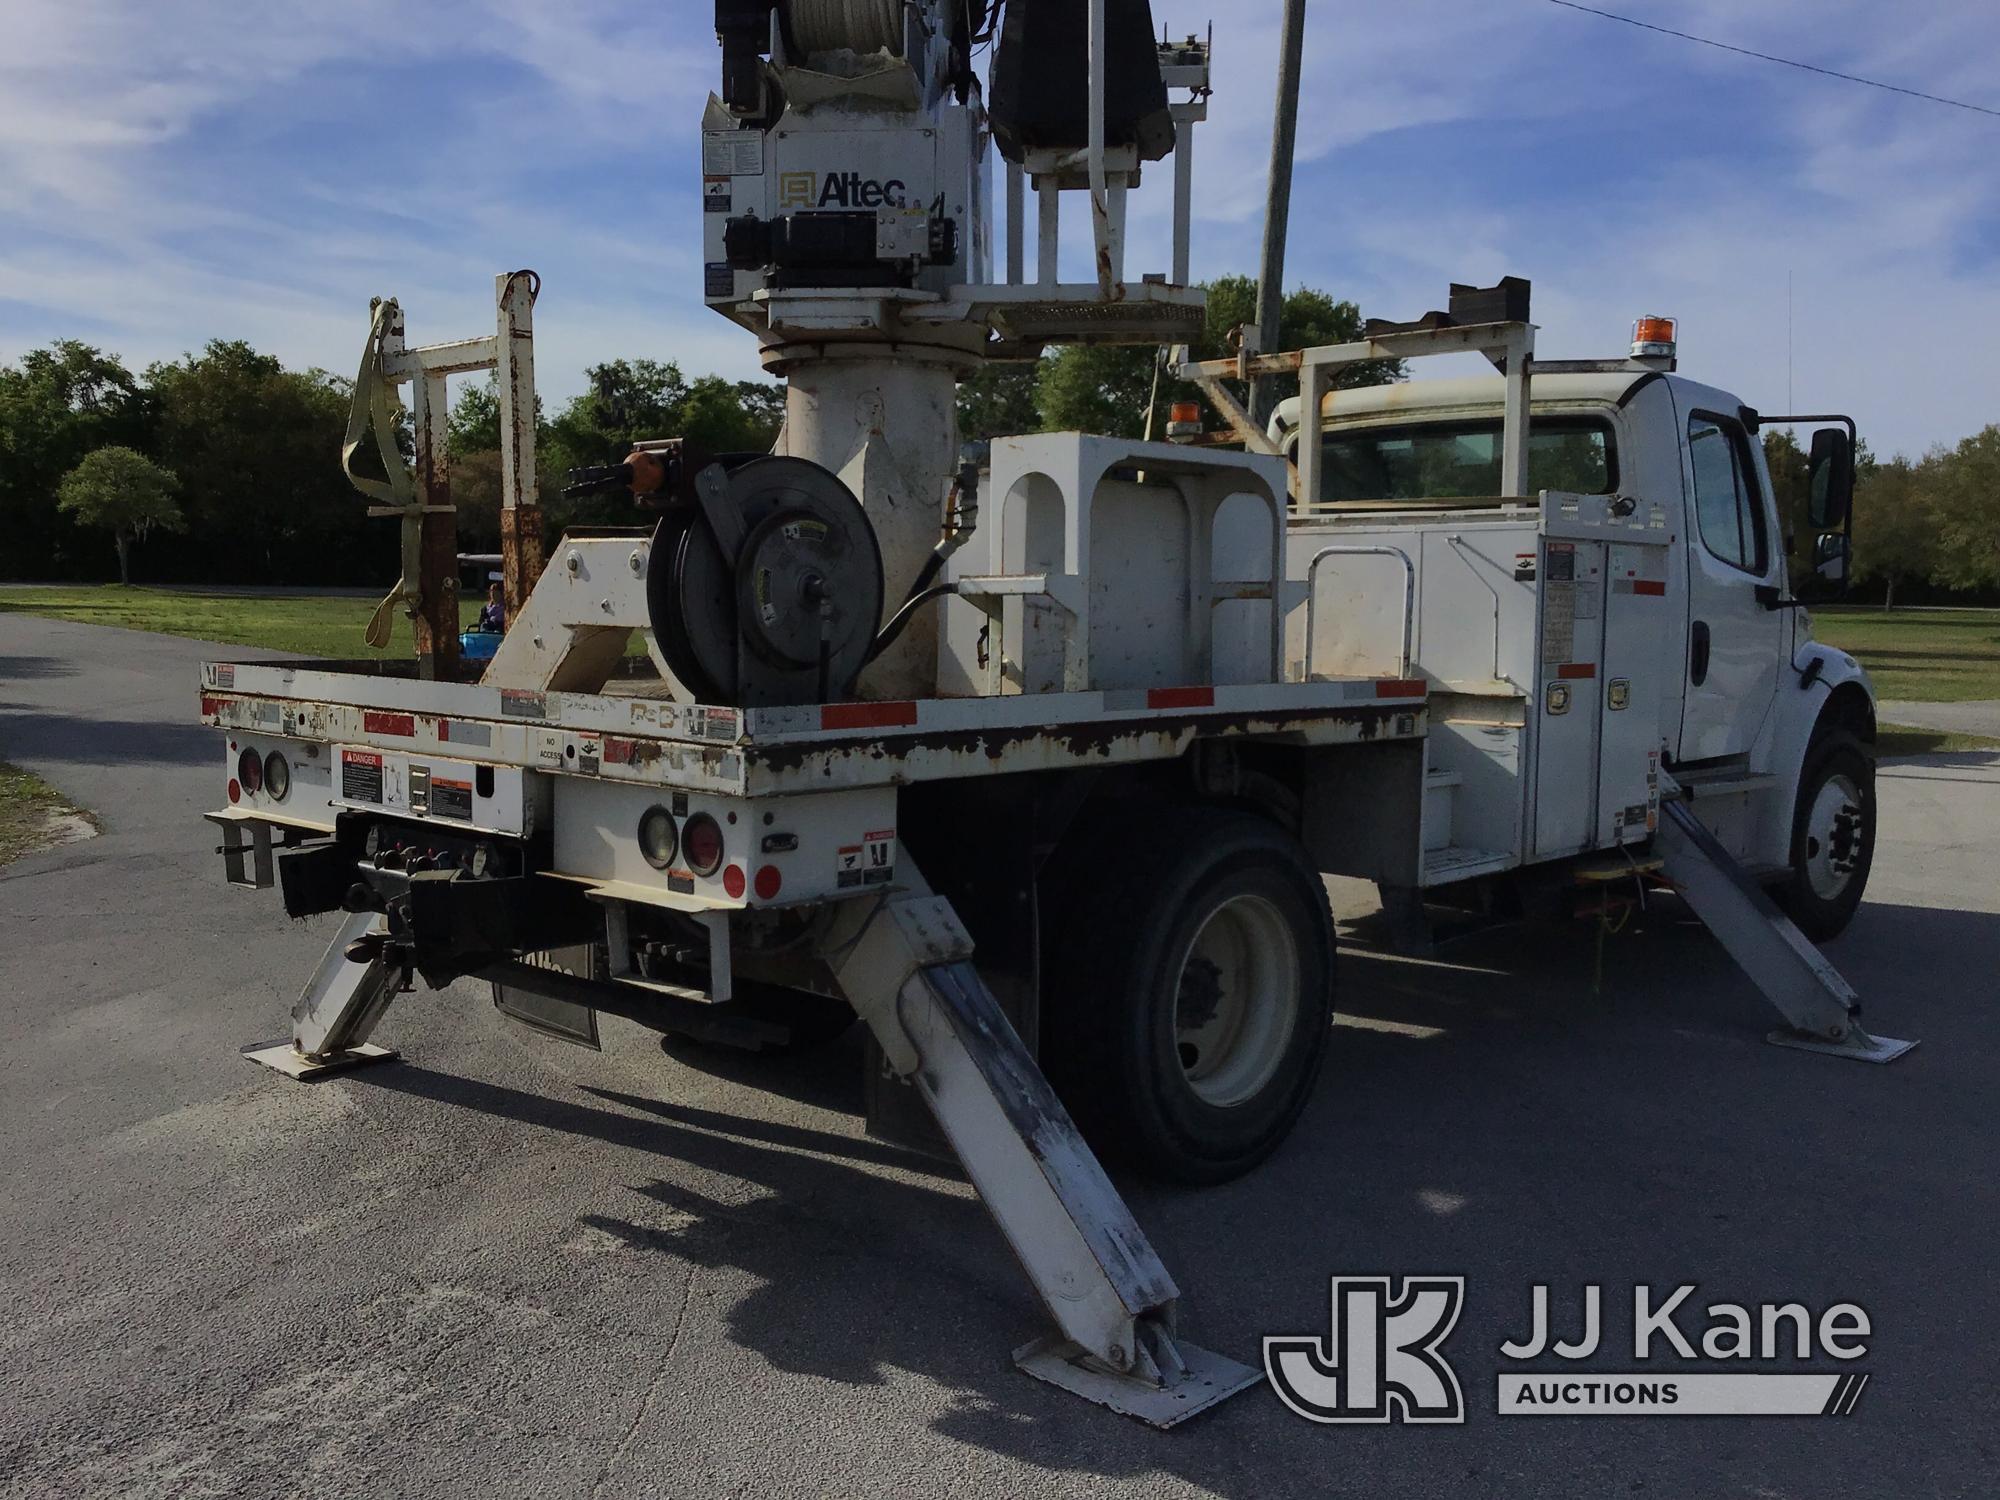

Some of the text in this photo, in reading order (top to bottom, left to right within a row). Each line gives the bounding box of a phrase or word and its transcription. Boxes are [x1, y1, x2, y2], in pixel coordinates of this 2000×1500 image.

[817, 171, 904, 207] Altec
[546, 737, 555, 746] NO
[352, 753, 377, 765] DANGER
[539, 749, 562, 760] ACCESS
